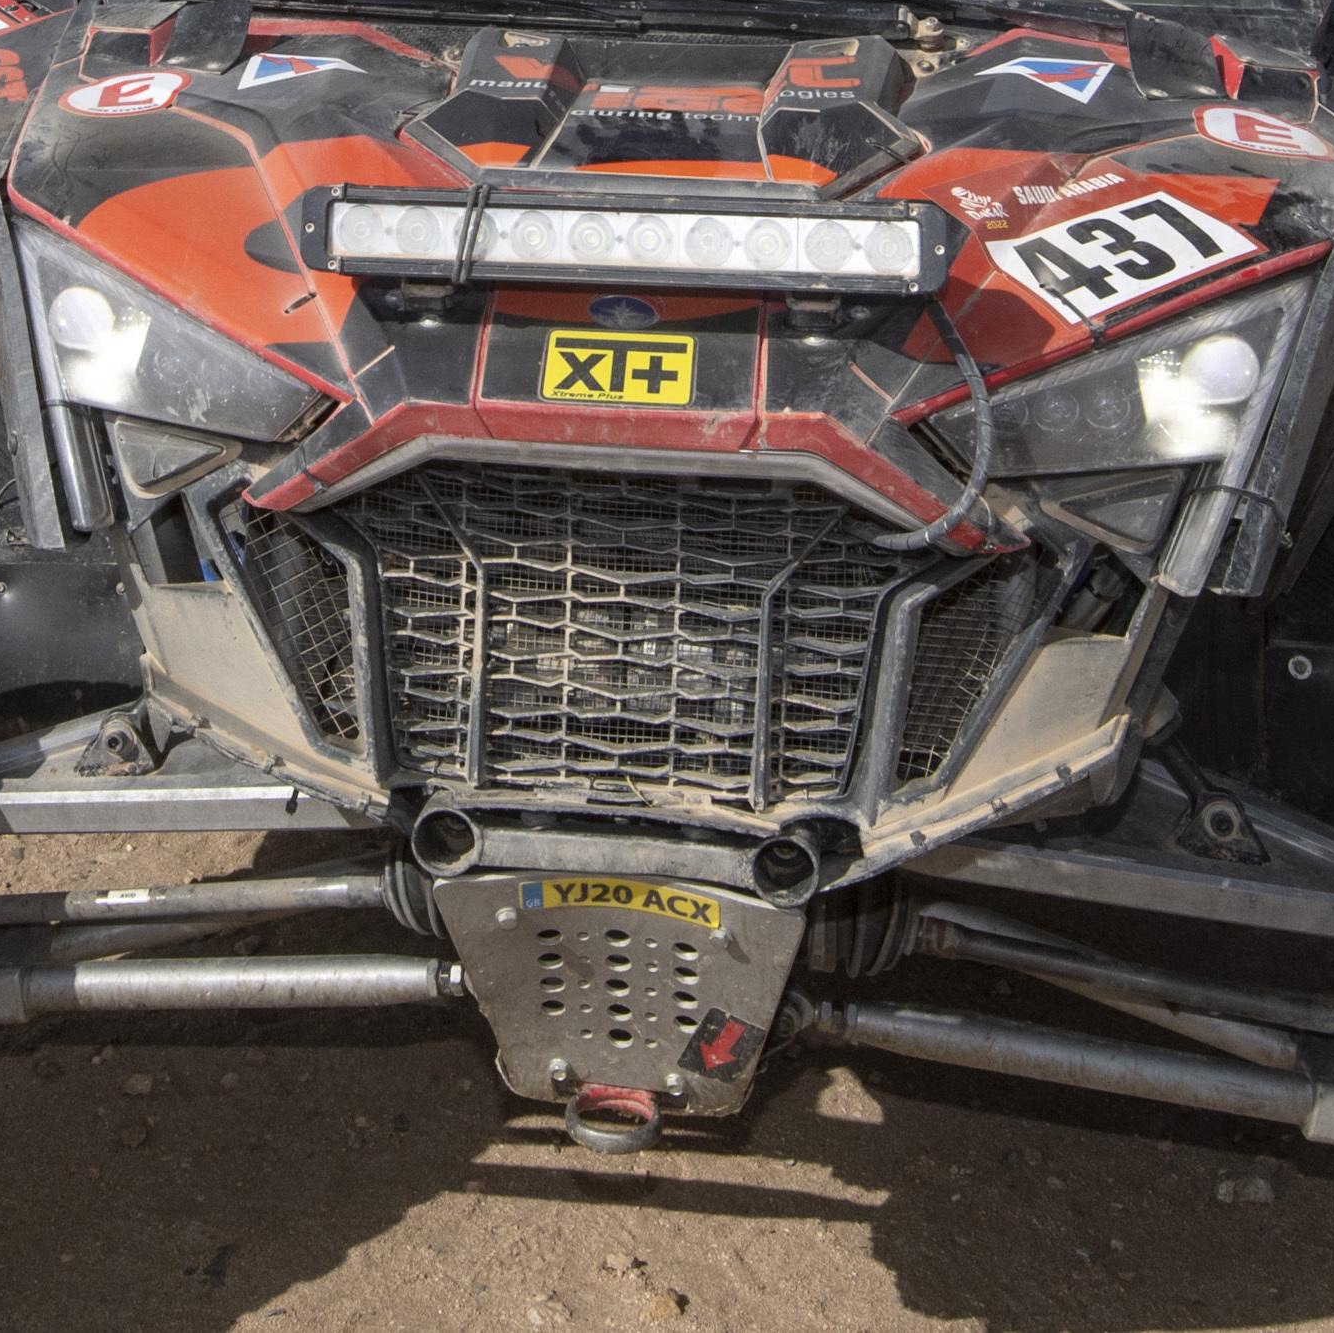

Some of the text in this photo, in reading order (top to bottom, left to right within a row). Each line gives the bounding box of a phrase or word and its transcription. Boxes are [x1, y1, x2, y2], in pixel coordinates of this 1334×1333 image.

[1012, 172, 1126, 206] SAUDI ARABIA
[985, 219, 1010, 230] 2022
[1013, 198, 1225, 301] 437
[550, 390, 624, 400] Xtreme Plus
[553, 883, 713, 924] YJ20 ACX
